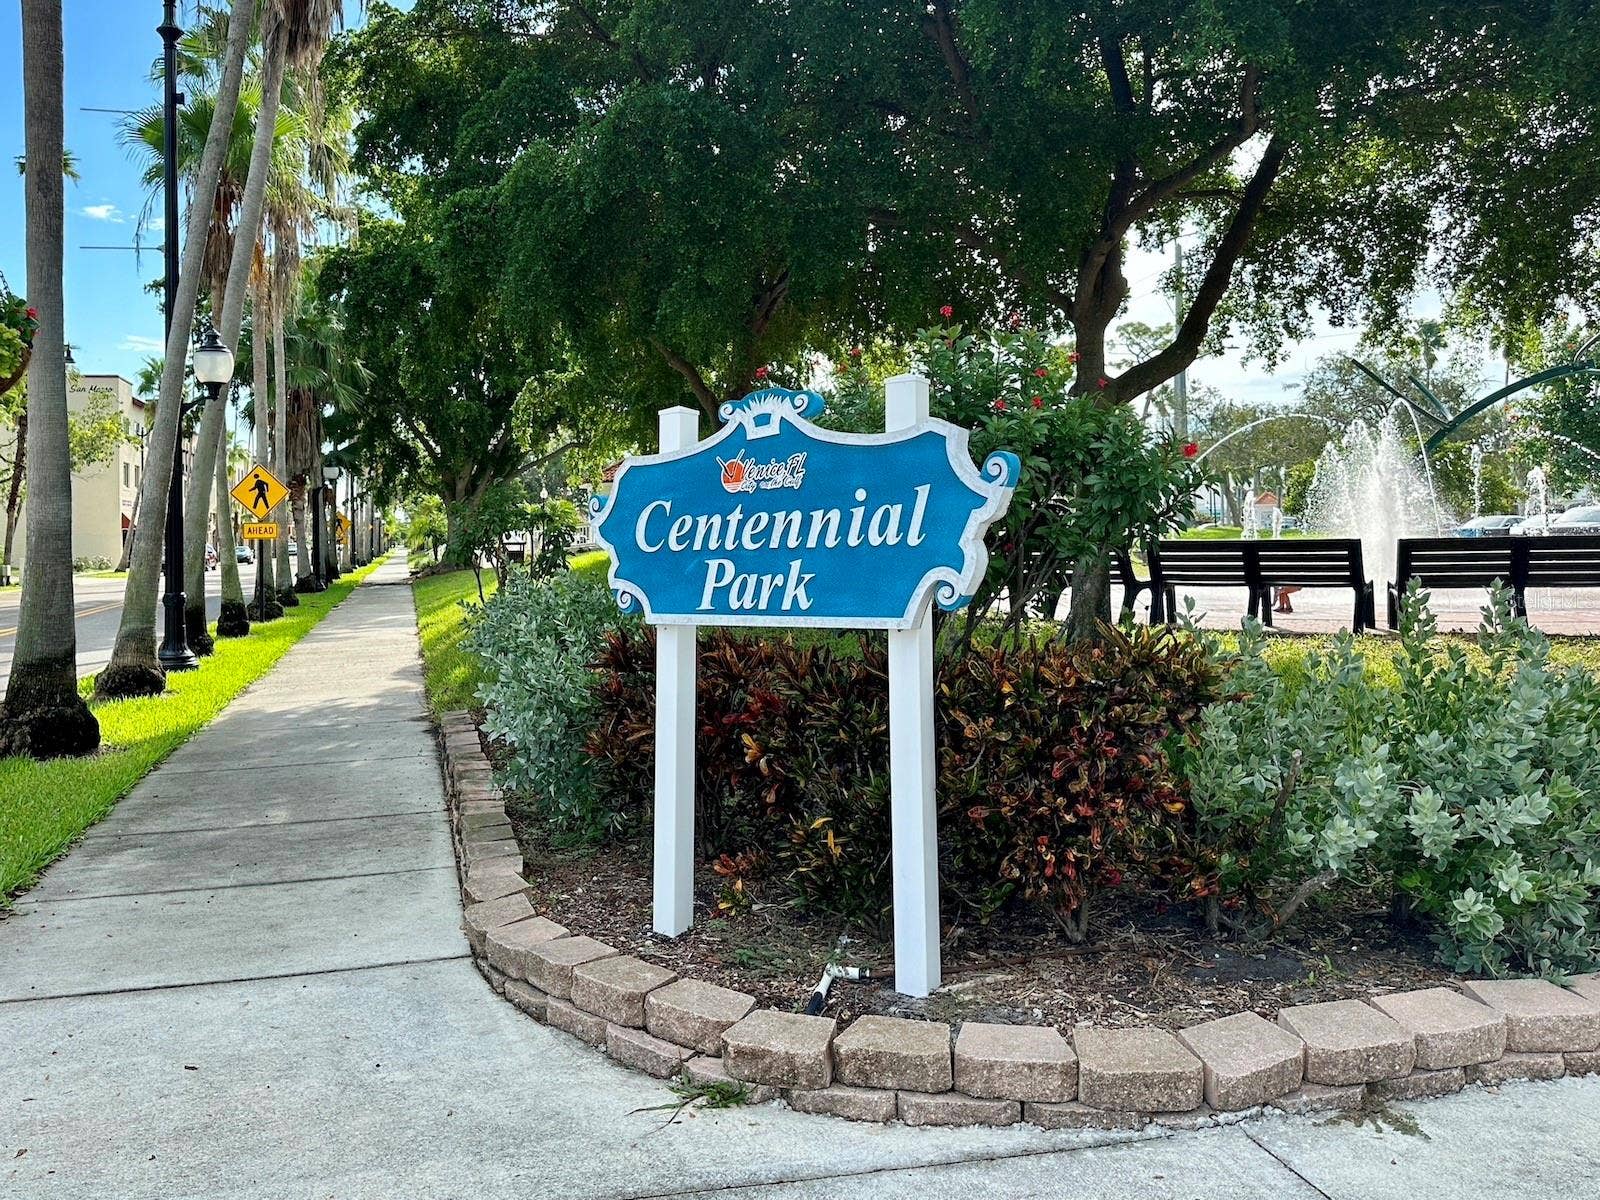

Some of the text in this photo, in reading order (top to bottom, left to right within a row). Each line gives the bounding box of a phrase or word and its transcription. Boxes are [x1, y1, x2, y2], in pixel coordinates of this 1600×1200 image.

[69, 384, 86, 393] San
[247, 527, 274, 535] AHEAD
[635, 484, 931, 552] Centennial
[696, 558, 816, 611] Park
